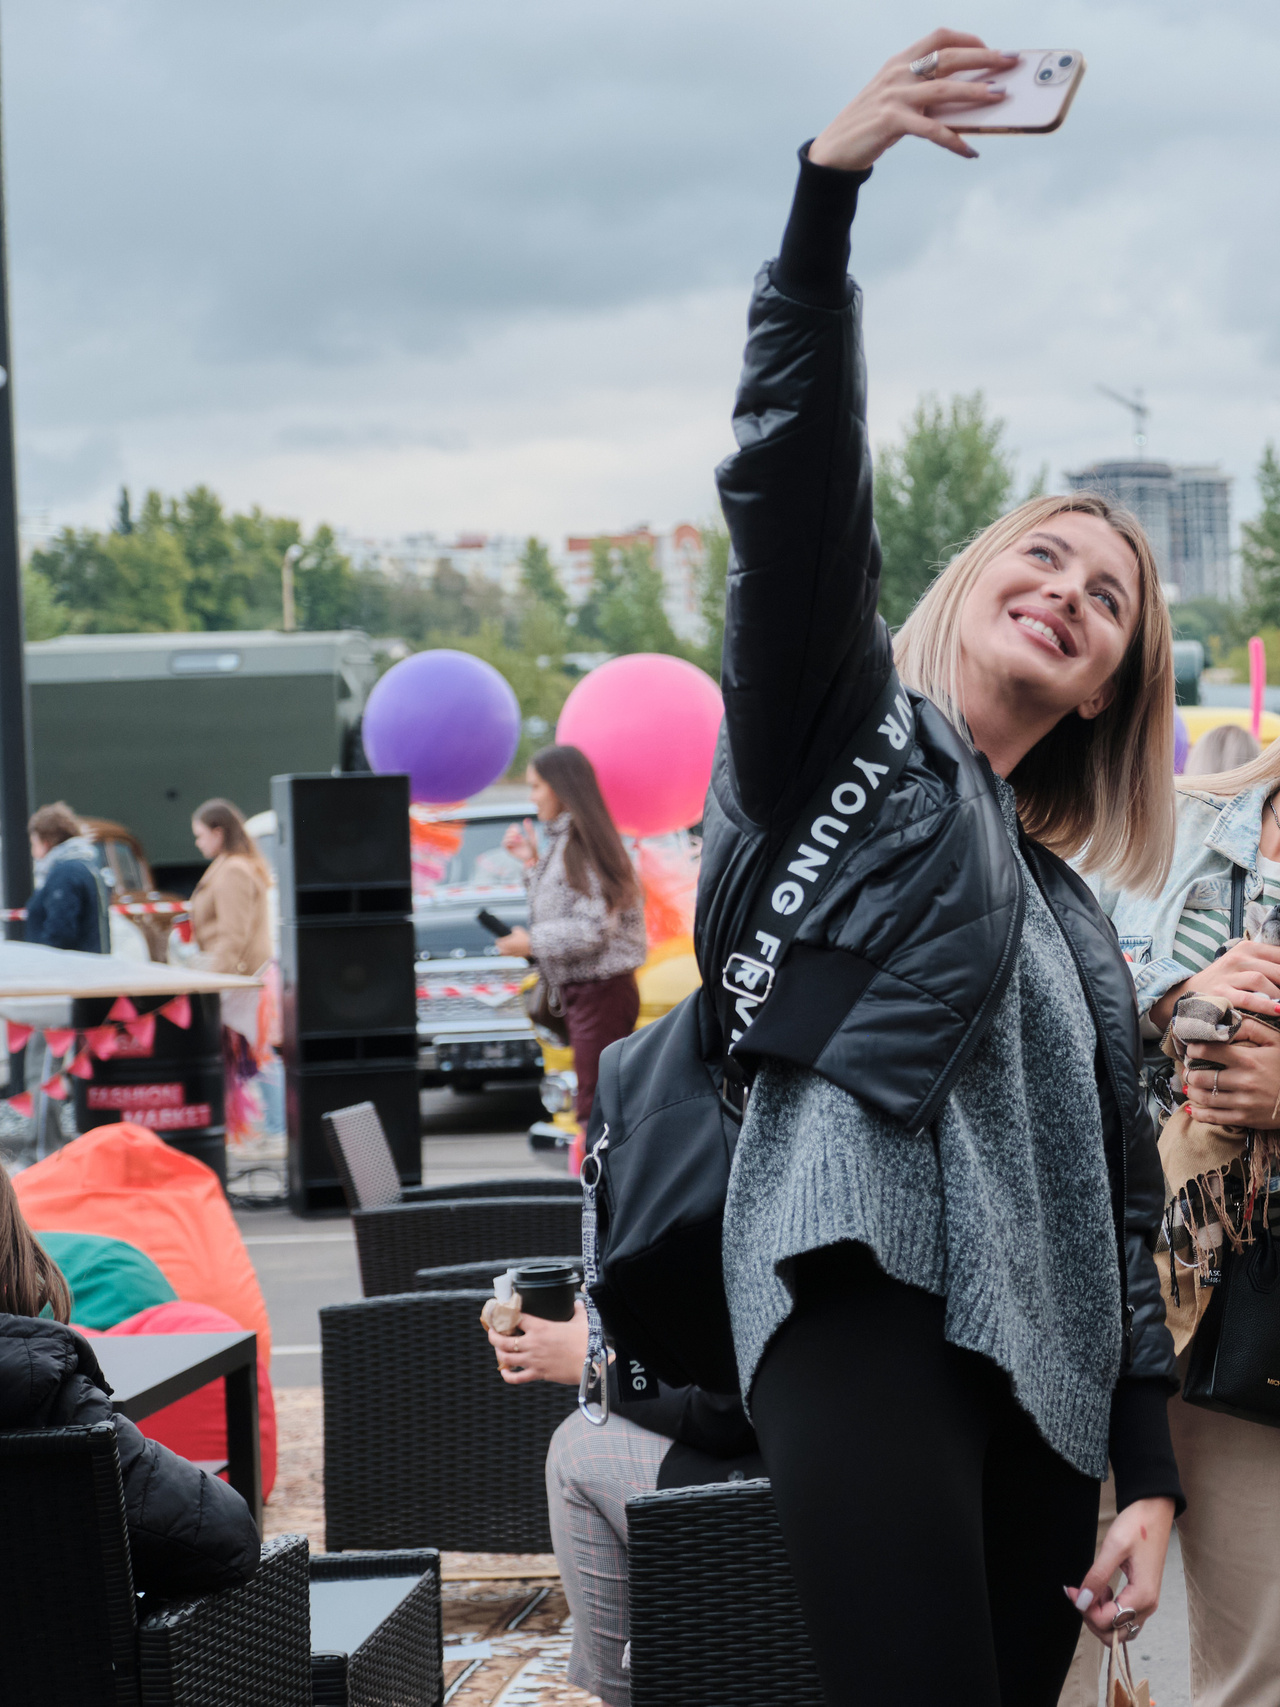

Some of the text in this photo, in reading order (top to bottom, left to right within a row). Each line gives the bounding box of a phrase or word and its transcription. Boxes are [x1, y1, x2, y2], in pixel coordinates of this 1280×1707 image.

[876, 681, 913, 751] VR
[771, 757, 889, 916] YOUNG
[123, 1105, 209, 1127] MARKET
